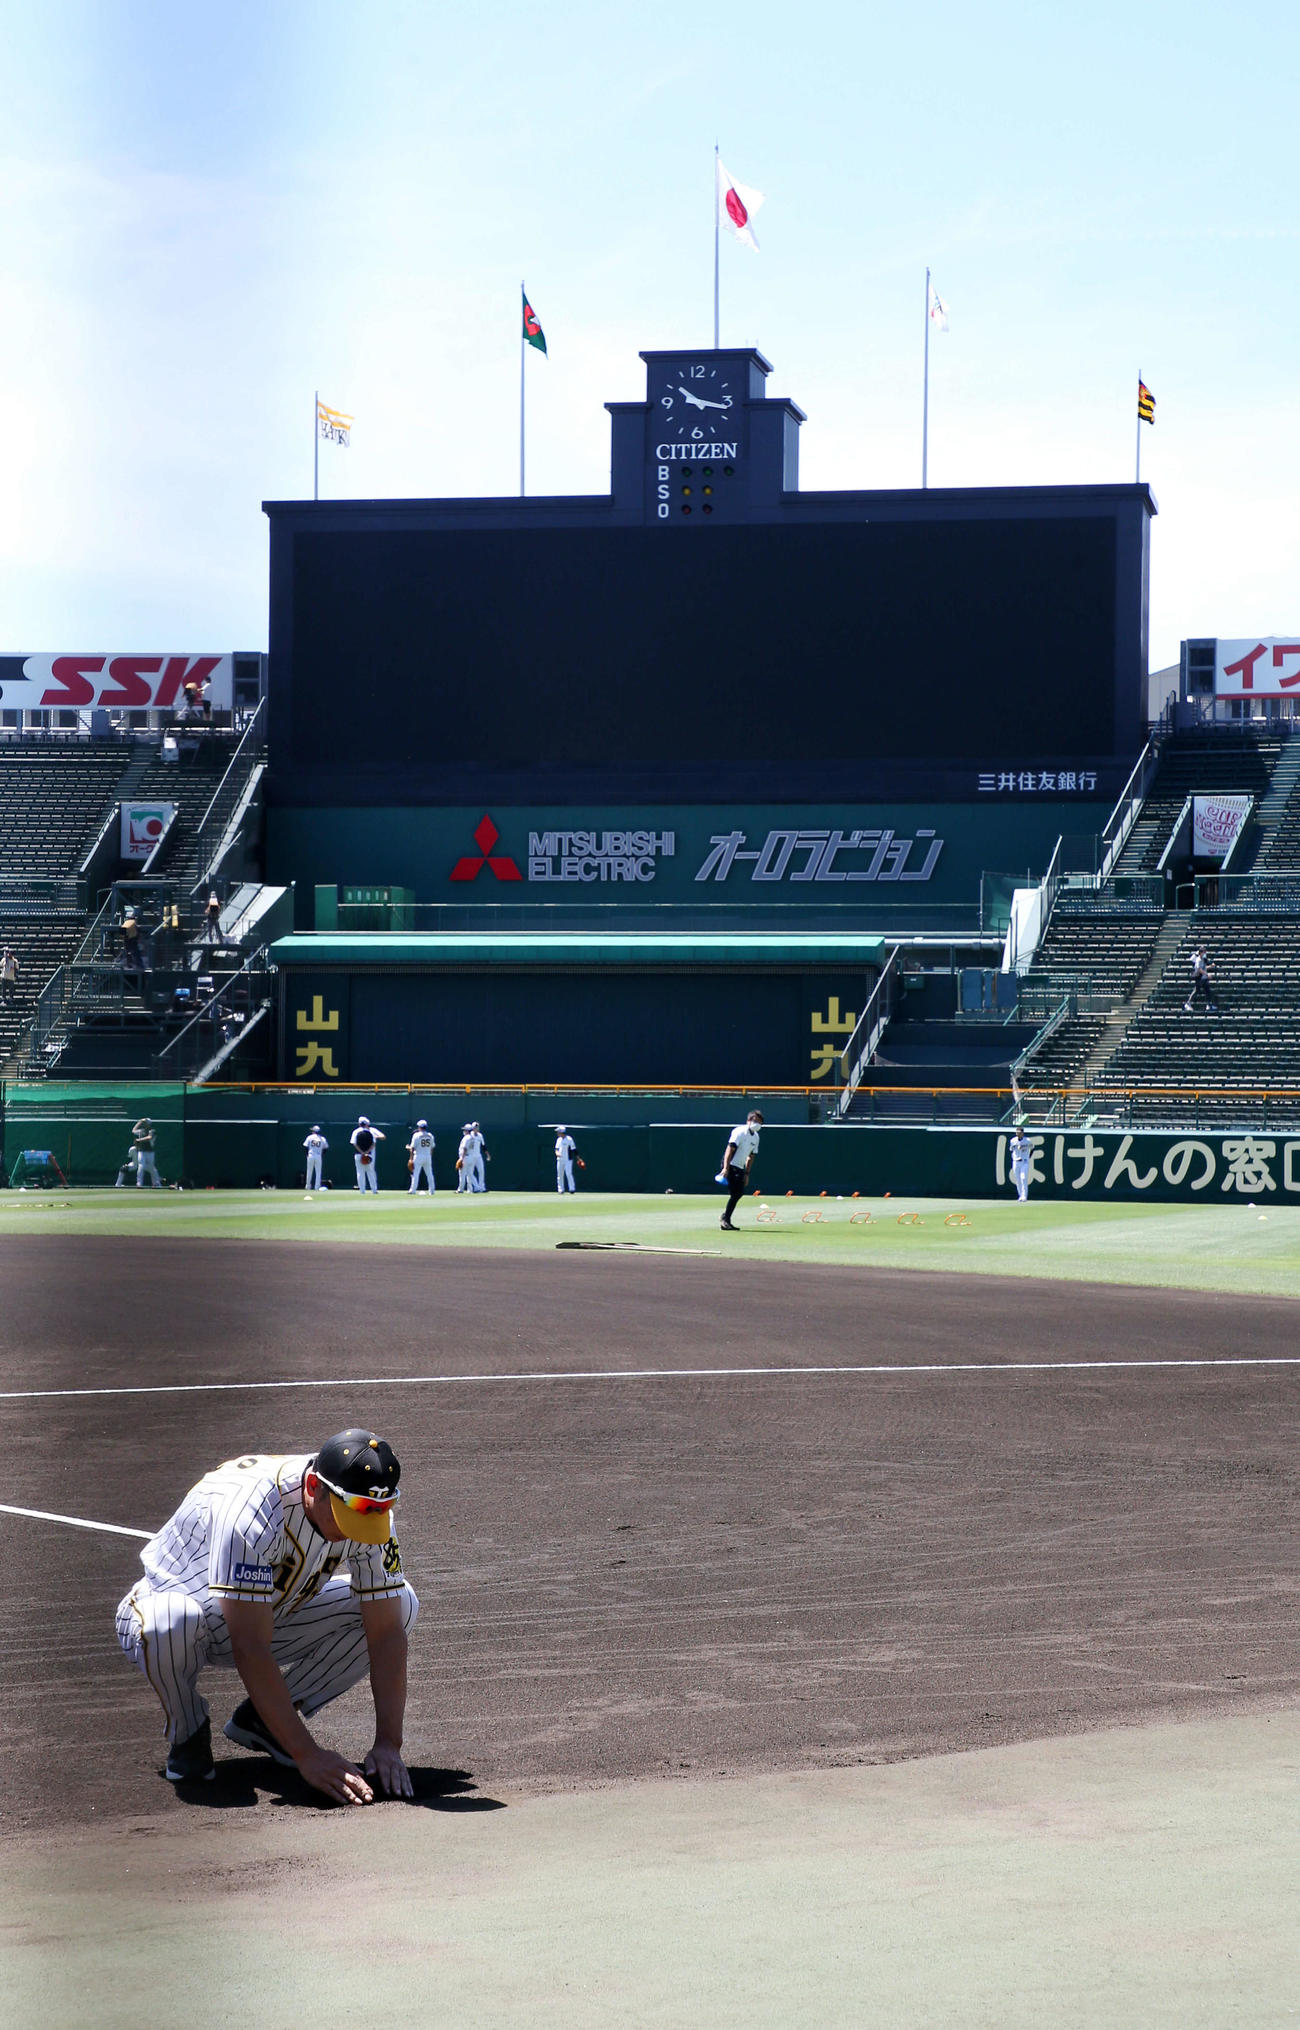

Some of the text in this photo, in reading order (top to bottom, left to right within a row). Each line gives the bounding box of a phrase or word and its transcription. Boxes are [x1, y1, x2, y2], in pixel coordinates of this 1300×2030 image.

[690, 366, 705, 378] 12
[661, 397, 673, 409] 9
[721, 395, 733, 408] 3
[691, 427, 704, 439] 6
[656, 442, 738, 460] CITIZEN
[39, 656, 223, 706] SSK
[977, 770, 1098, 792] 三井住友銀行
[528, 831, 675, 856] MITSUBISHI
[694, 829, 945, 882] オーロラビジョン
[528, 857, 656, 882] ELECTRIC
[295, 995, 339, 1077] 山九
[236, 1567, 271, 1582] Joshin
